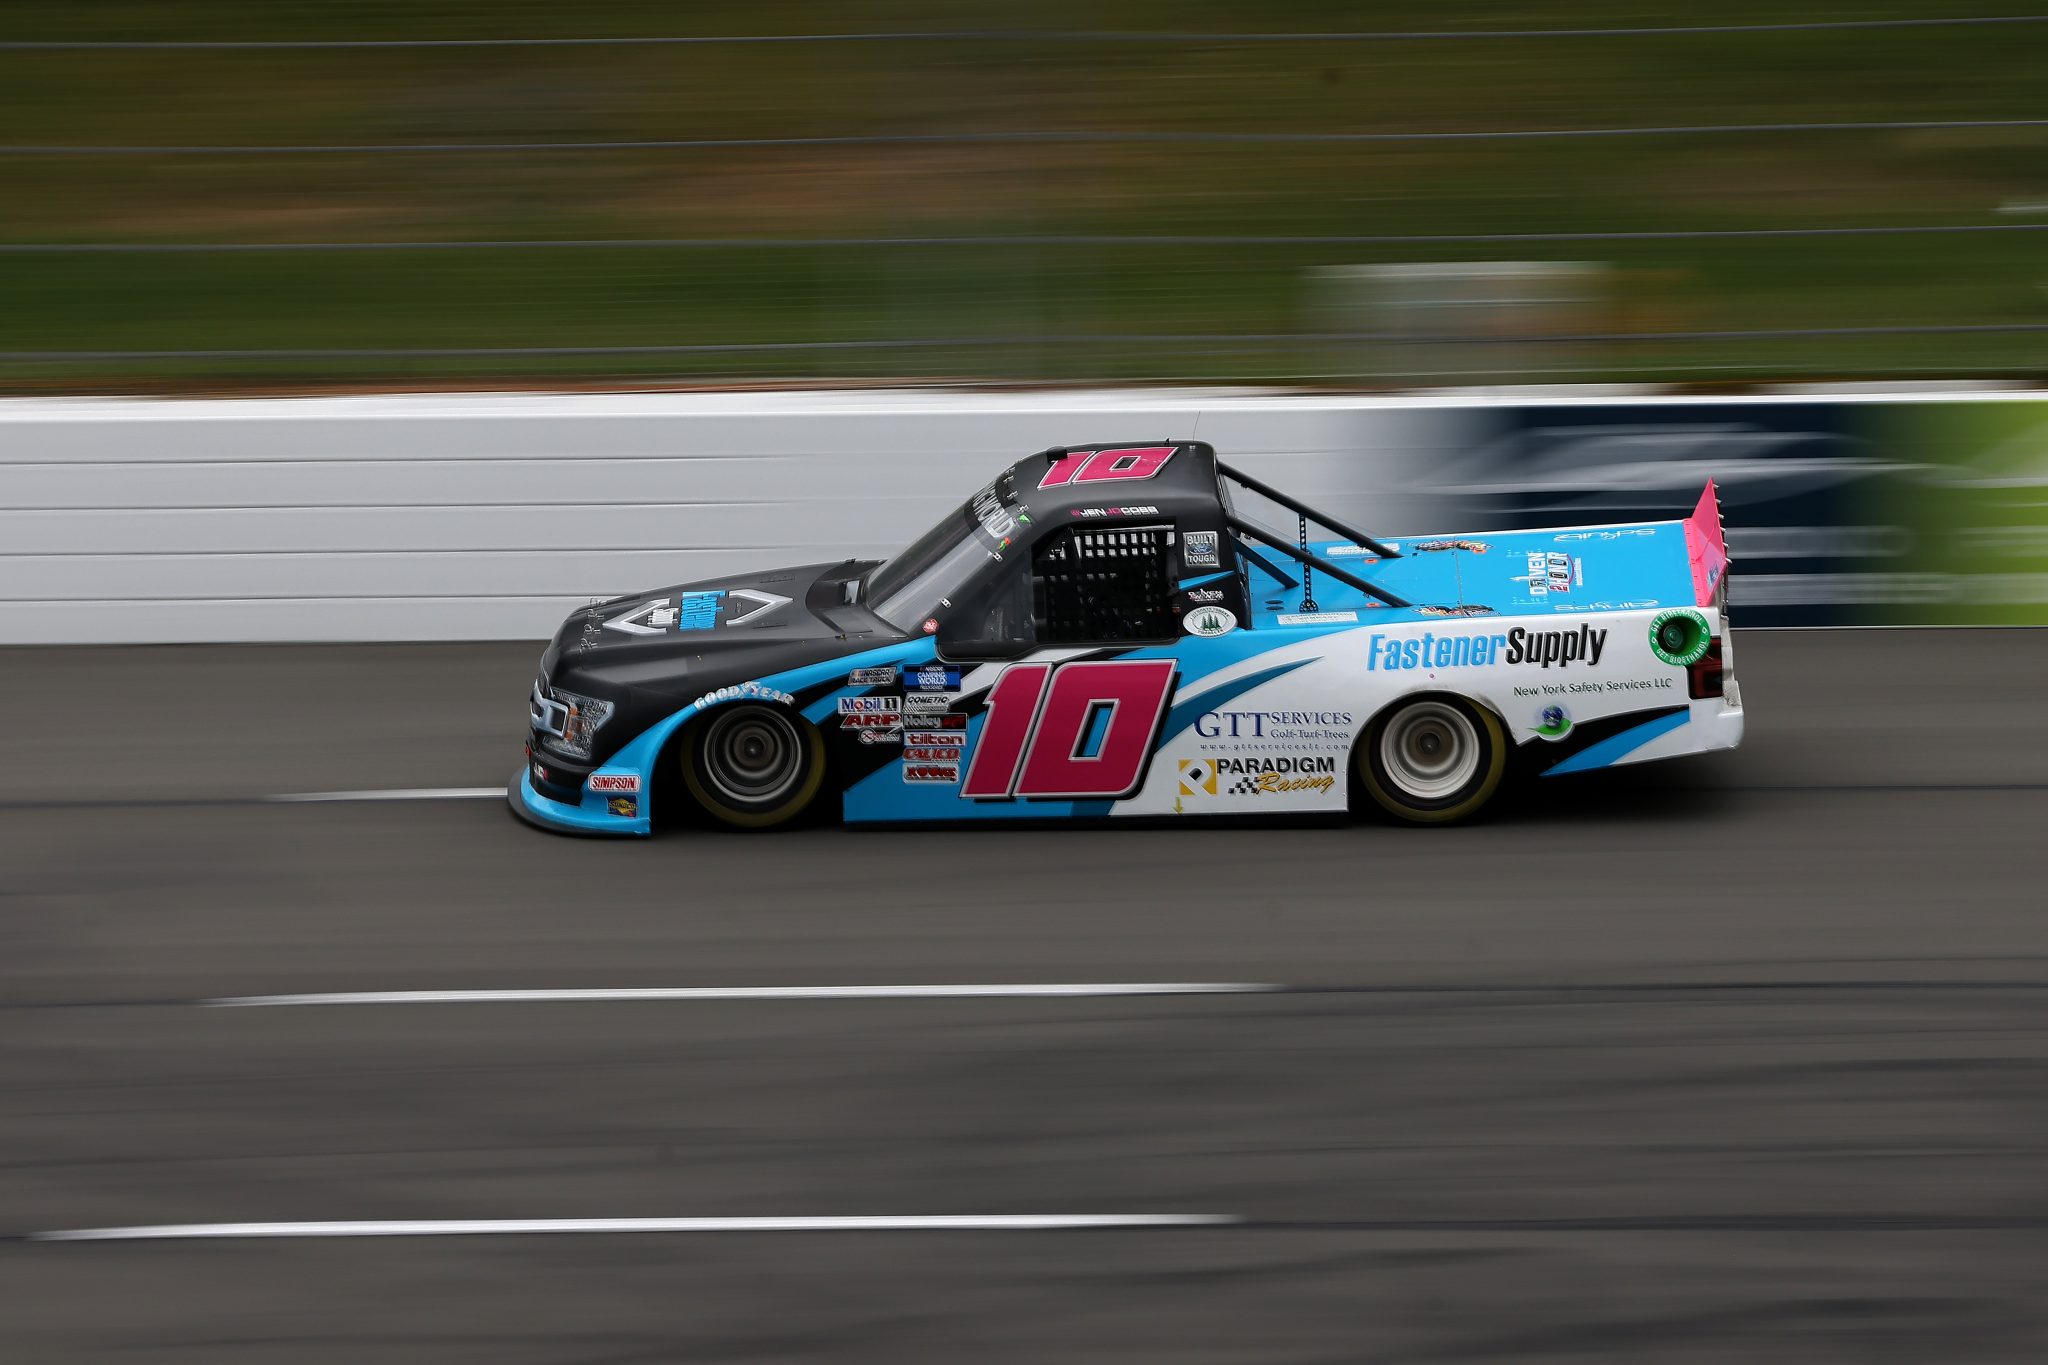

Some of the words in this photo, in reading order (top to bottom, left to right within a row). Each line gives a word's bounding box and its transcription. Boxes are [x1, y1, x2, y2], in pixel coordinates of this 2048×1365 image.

[1037, 446, 1179, 490] 10
[1187, 535, 1215, 545] BUILT
[1188, 555, 1216, 563] TOUGH
[1651, 619, 1663, 632] GET
[1656, 648, 1668, 660] GET
[1669, 638, 1709, 665] BIOETHANOL
[1513, 685, 1539, 697] New
[1541, 683, 1566, 695] York
[1569, 681, 1603, 695] Safety
[1605, 679, 1653, 692] Services
[1654, 677, 1673, 689] LLC
[842, 697, 881, 710] Mobil
[843, 713, 901, 727] ARP
[904, 715, 942, 729] Holley
[1193, 711, 1271, 738] GTT
[1271, 711, 1353, 725] SERVICES
[960, 658, 1178, 799] 10
[908, 733, 964, 745] tilton
[1216, 757, 1335, 775] PARADIGM
[592, 777, 636, 789] SIMPSON
[1255, 772, 1336, 795] Racing
